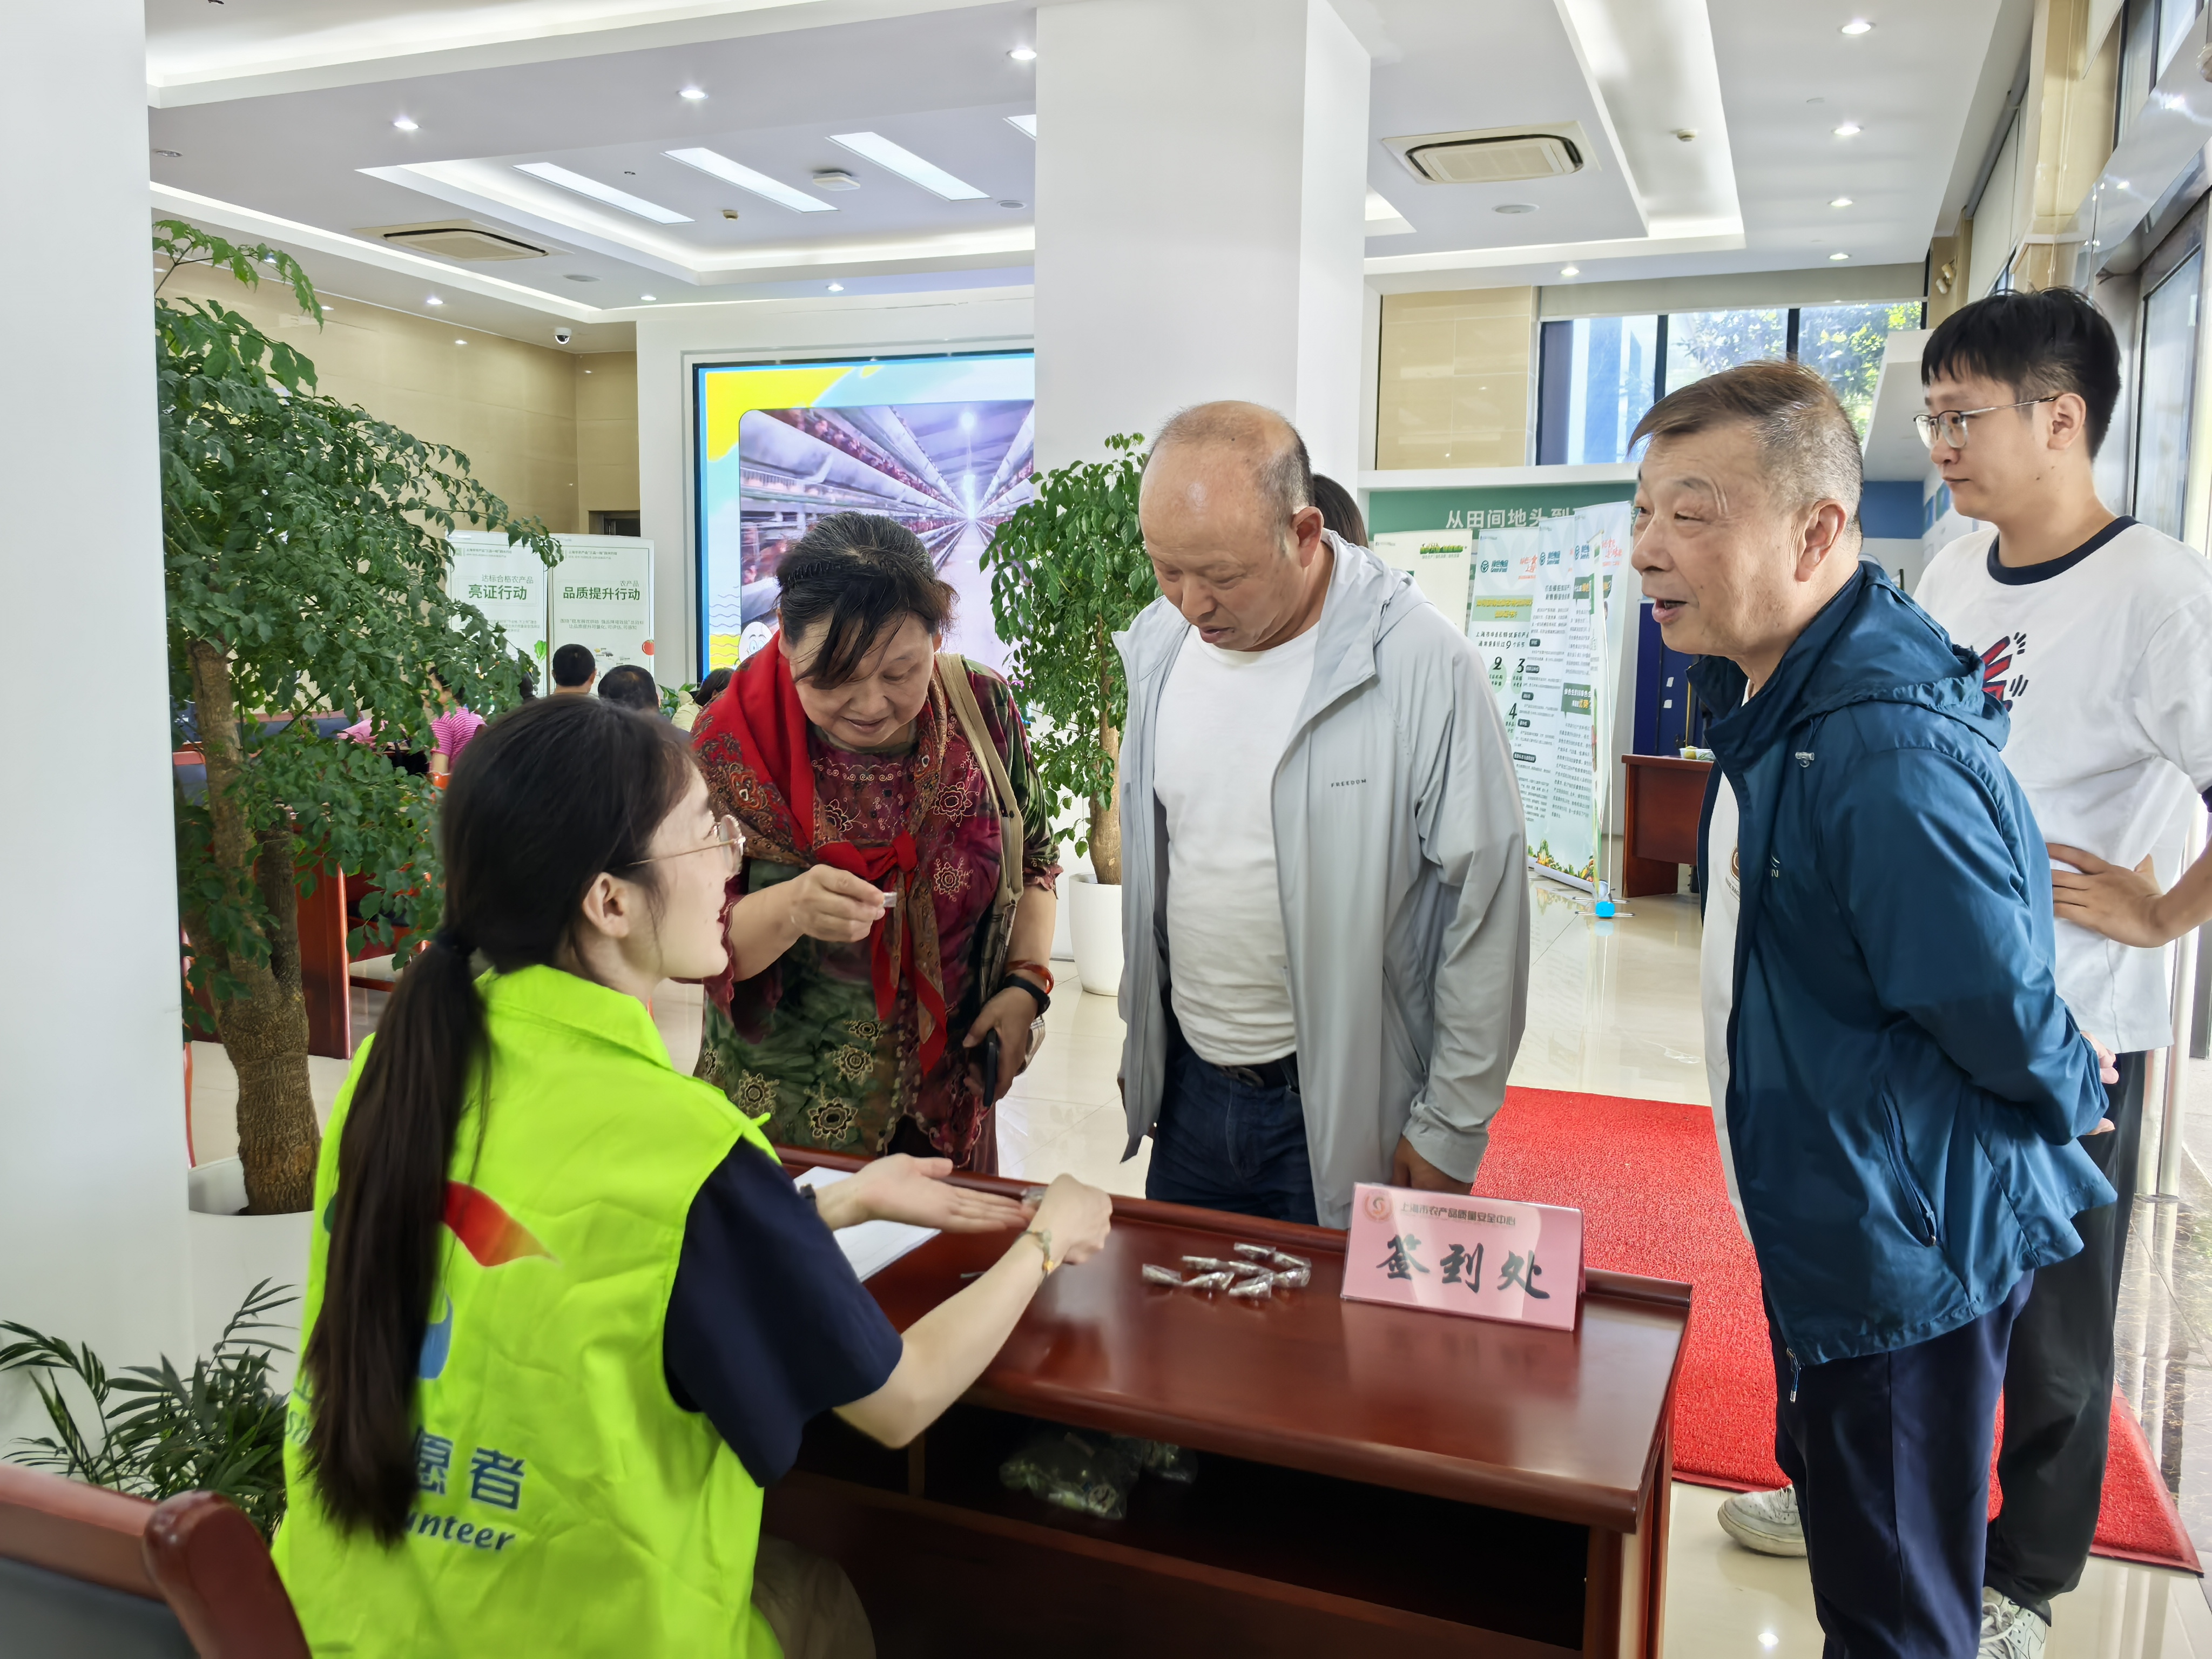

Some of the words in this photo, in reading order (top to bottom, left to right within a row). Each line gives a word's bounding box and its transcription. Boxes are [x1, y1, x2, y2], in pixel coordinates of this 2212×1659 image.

[1446, 507, 1571, 529] 从田间地头到
[482, 574, 534, 584] 达标合格农产品
[468, 584, 527, 600] 亮证行动
[563, 586, 640, 600] 品质提升行动
[1492, 656, 1502, 670] 2
[1516, 658, 1526, 673] 3
[1508, 703, 1518, 720] 4
[1331, 779, 1366, 788] FREEDOM
[1401, 1201, 1516, 1226] 上海市农产品质量安全中心
[1375, 1233, 1550, 1299] 签到处
